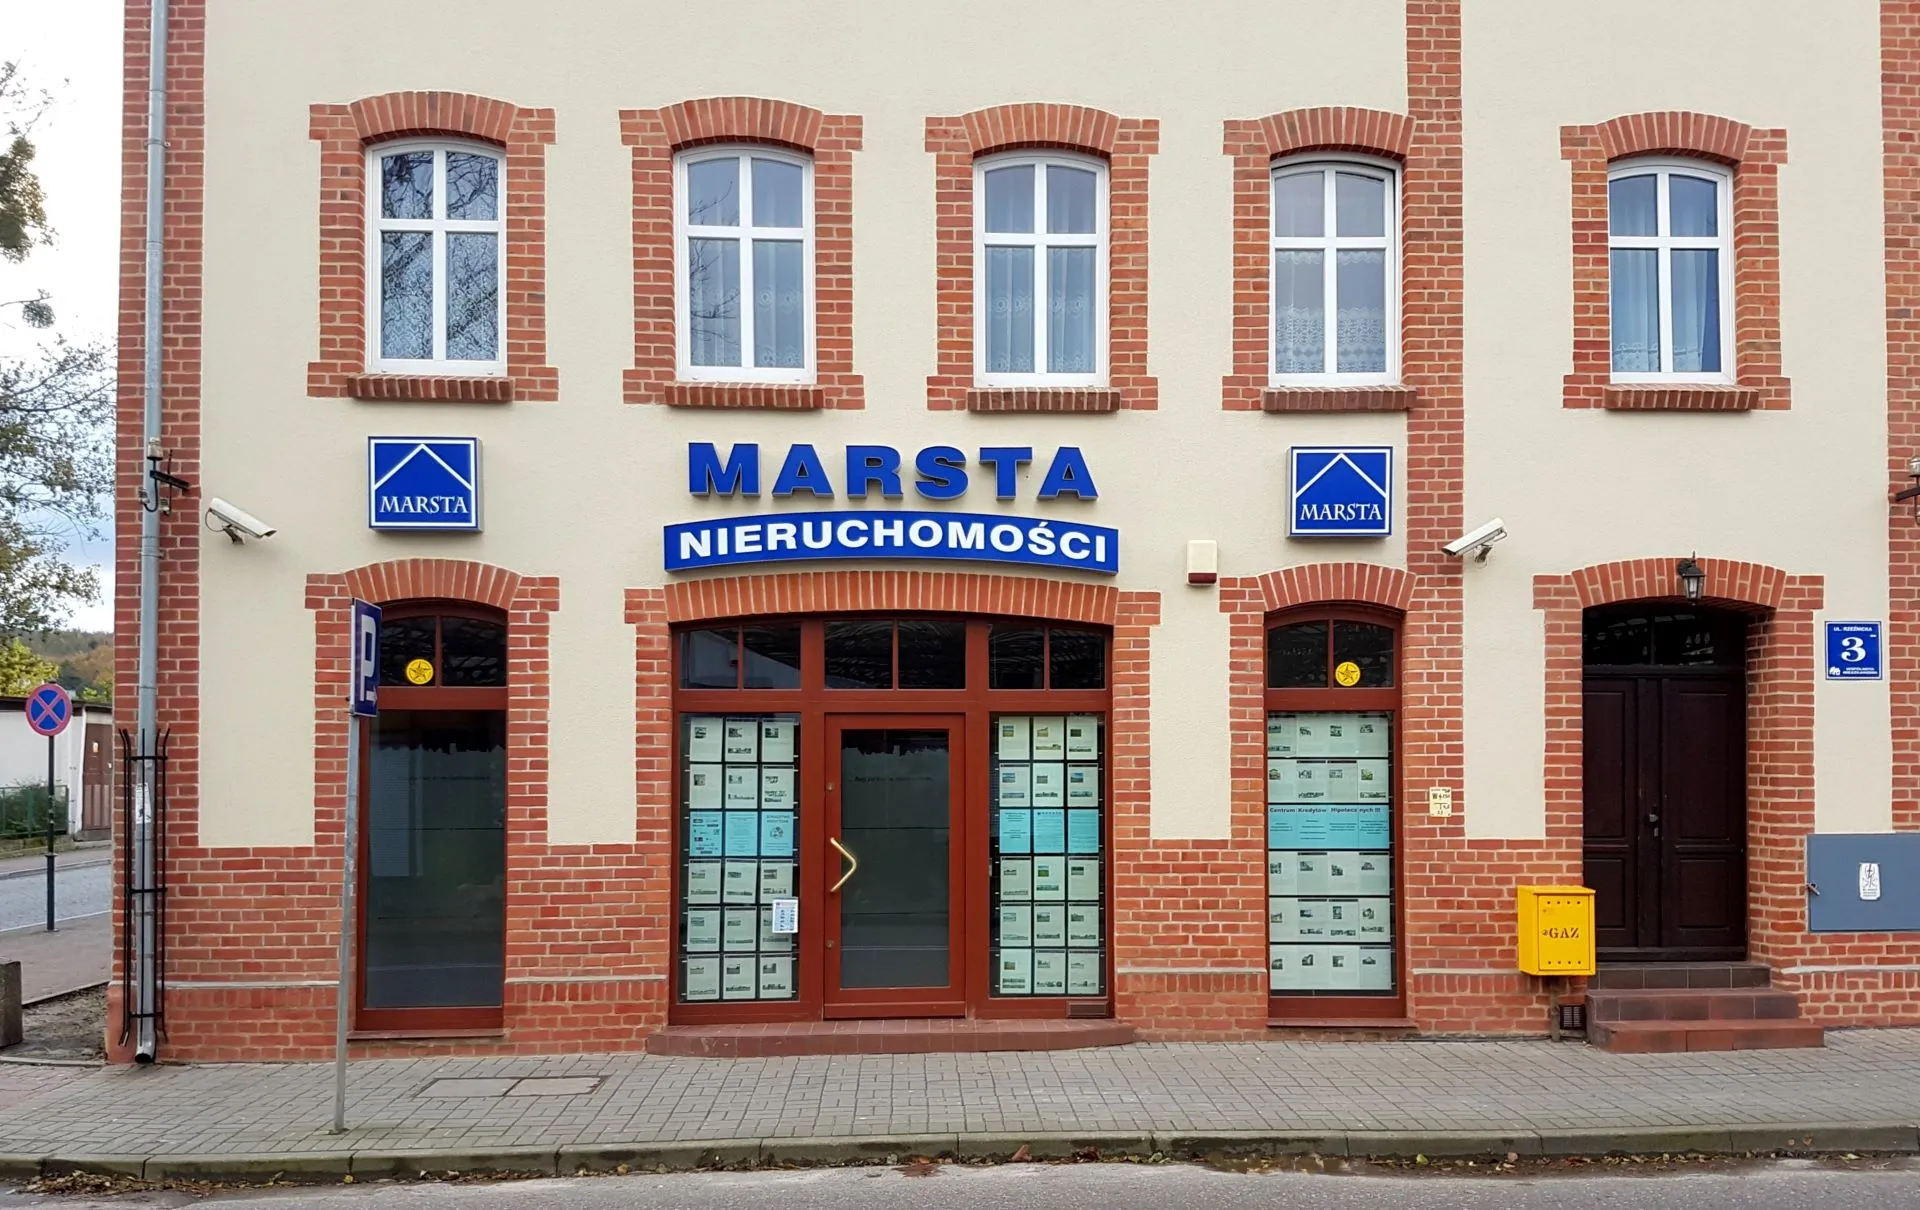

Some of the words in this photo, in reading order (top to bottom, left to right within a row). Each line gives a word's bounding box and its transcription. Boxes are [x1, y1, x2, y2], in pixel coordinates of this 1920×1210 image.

[688, 442, 1099, 500] MARSTA
[379, 495, 469, 514] MARSTA
[1300, 502, 1383, 521] MARSTA
[680, 519, 1107, 563] NIERUCHOMOŚCI
[360, 614, 377, 701] P
[1841, 636, 1867, 662] 3
[1548, 927, 1579, 939] GAZ
